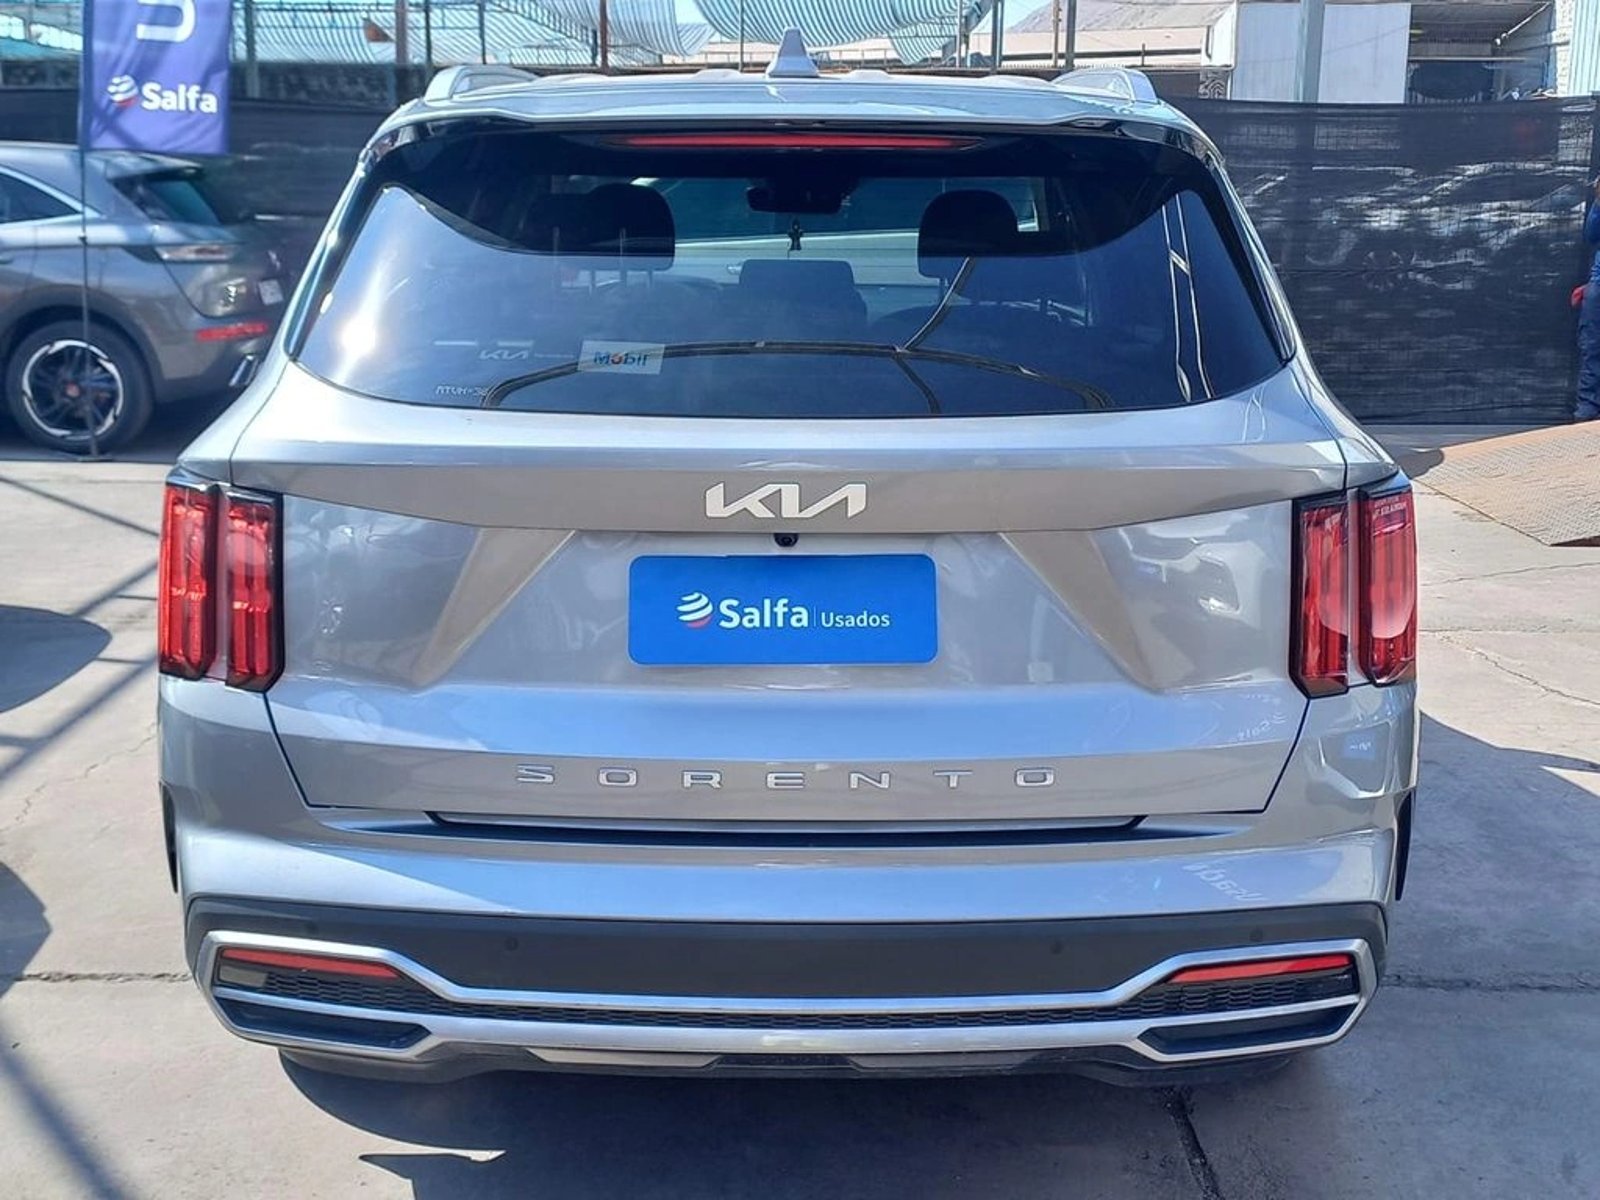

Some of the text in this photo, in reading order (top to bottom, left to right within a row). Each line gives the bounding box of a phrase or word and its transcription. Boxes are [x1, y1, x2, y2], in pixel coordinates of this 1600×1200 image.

[141, 81, 218, 114] Salfa
[705, 482, 867, 518] KIA
[718, 598, 891, 629] Salfa Usados
[515, 762, 1056, 790] SORENTO
